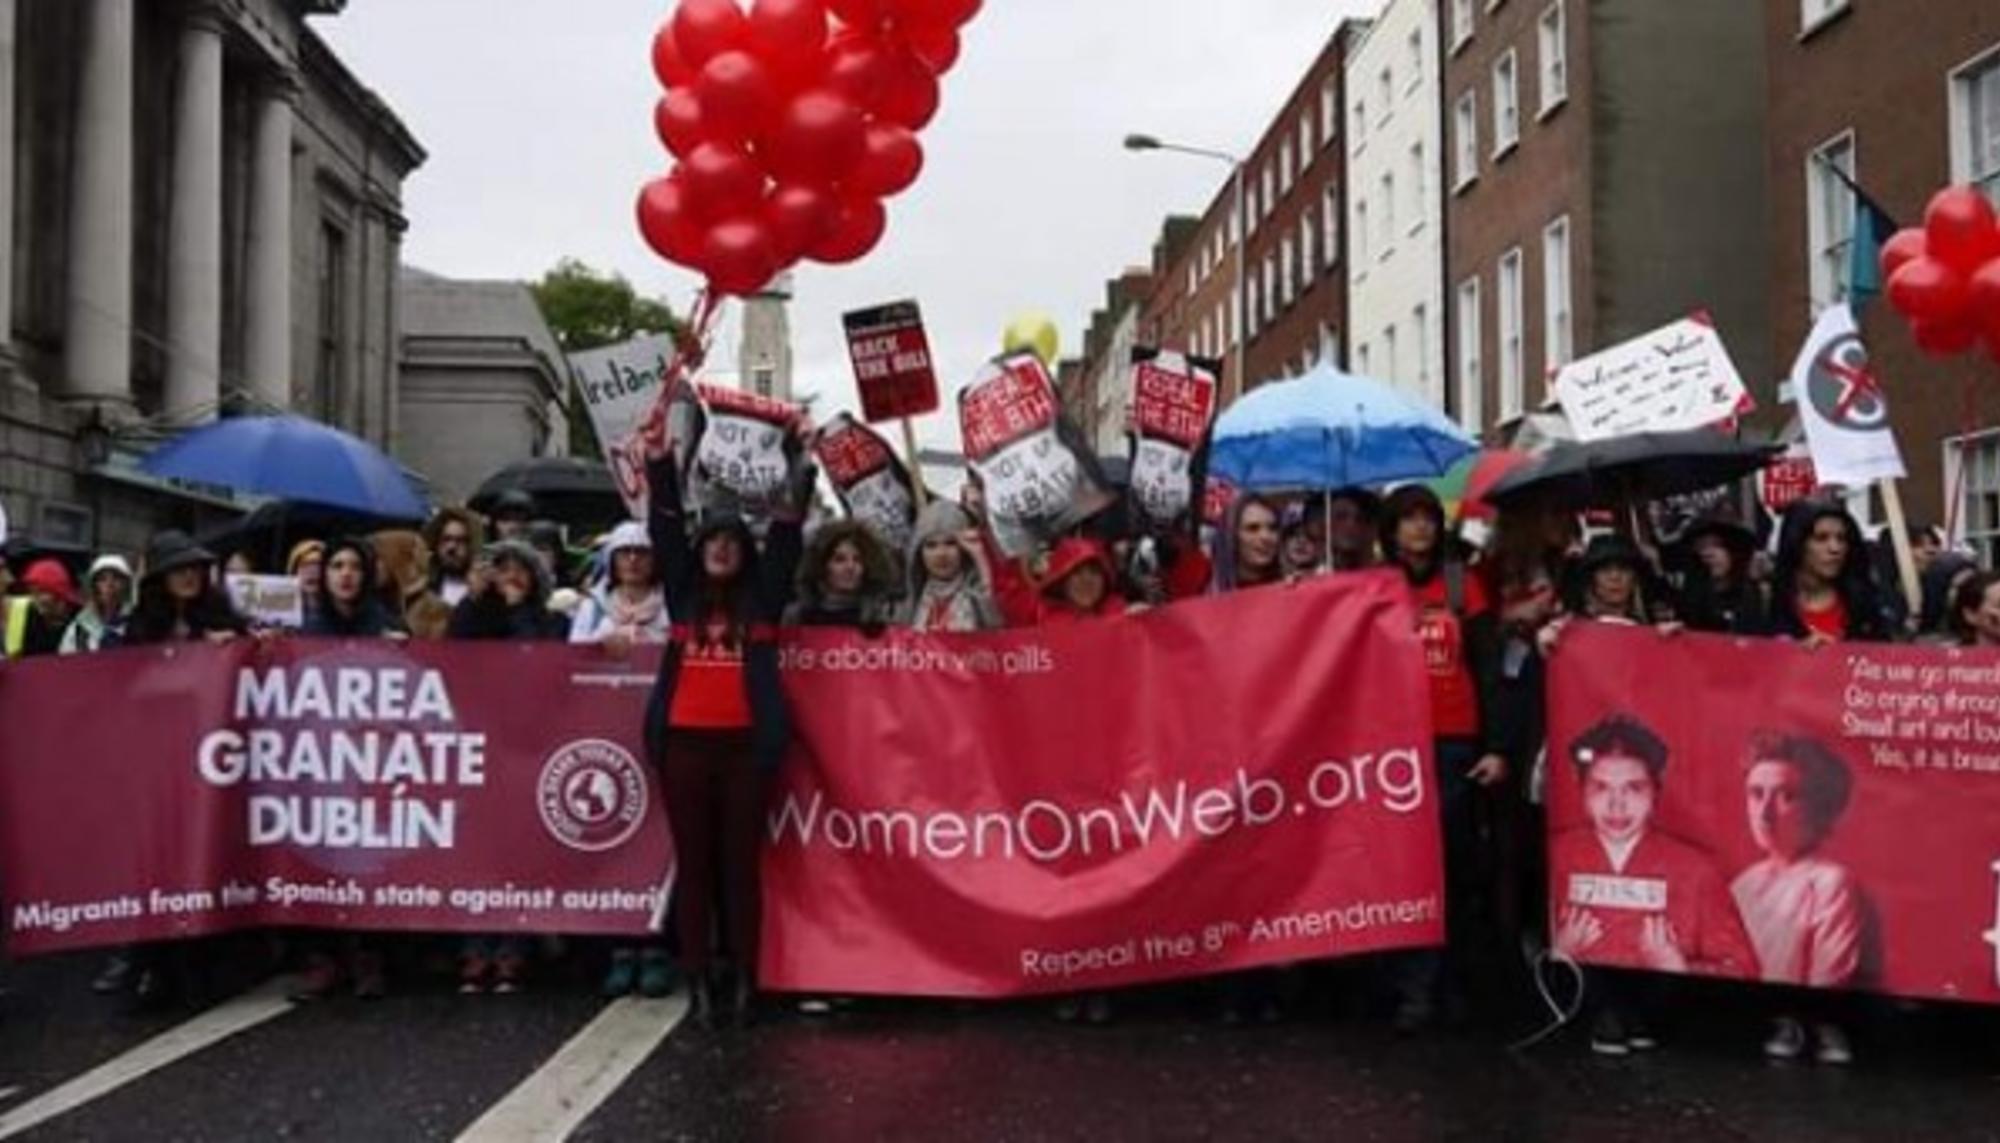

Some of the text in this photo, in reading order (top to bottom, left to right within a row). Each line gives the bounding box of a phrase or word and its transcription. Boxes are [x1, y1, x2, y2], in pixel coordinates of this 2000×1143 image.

[575, 353, 668, 405] Ireland
[821, 642, 945, 671] abortion
[1920, 665, 1945, 689] go
[235, 666, 454, 721] MAREA
[1844, 684, 1874, 709] Go
[1933, 718, 1970, 741] and
[198, 729, 487, 787] GRANATE
[248, 783, 455, 849] DUBLÍN
[767, 747, 1422, 861] WomenOnWeb.org
[14, 876, 666, 931] Migrants from the Spanish state against austeri
[1020, 937, 1135, 977] Repeal
[1144, 927, 1196, 961] the
